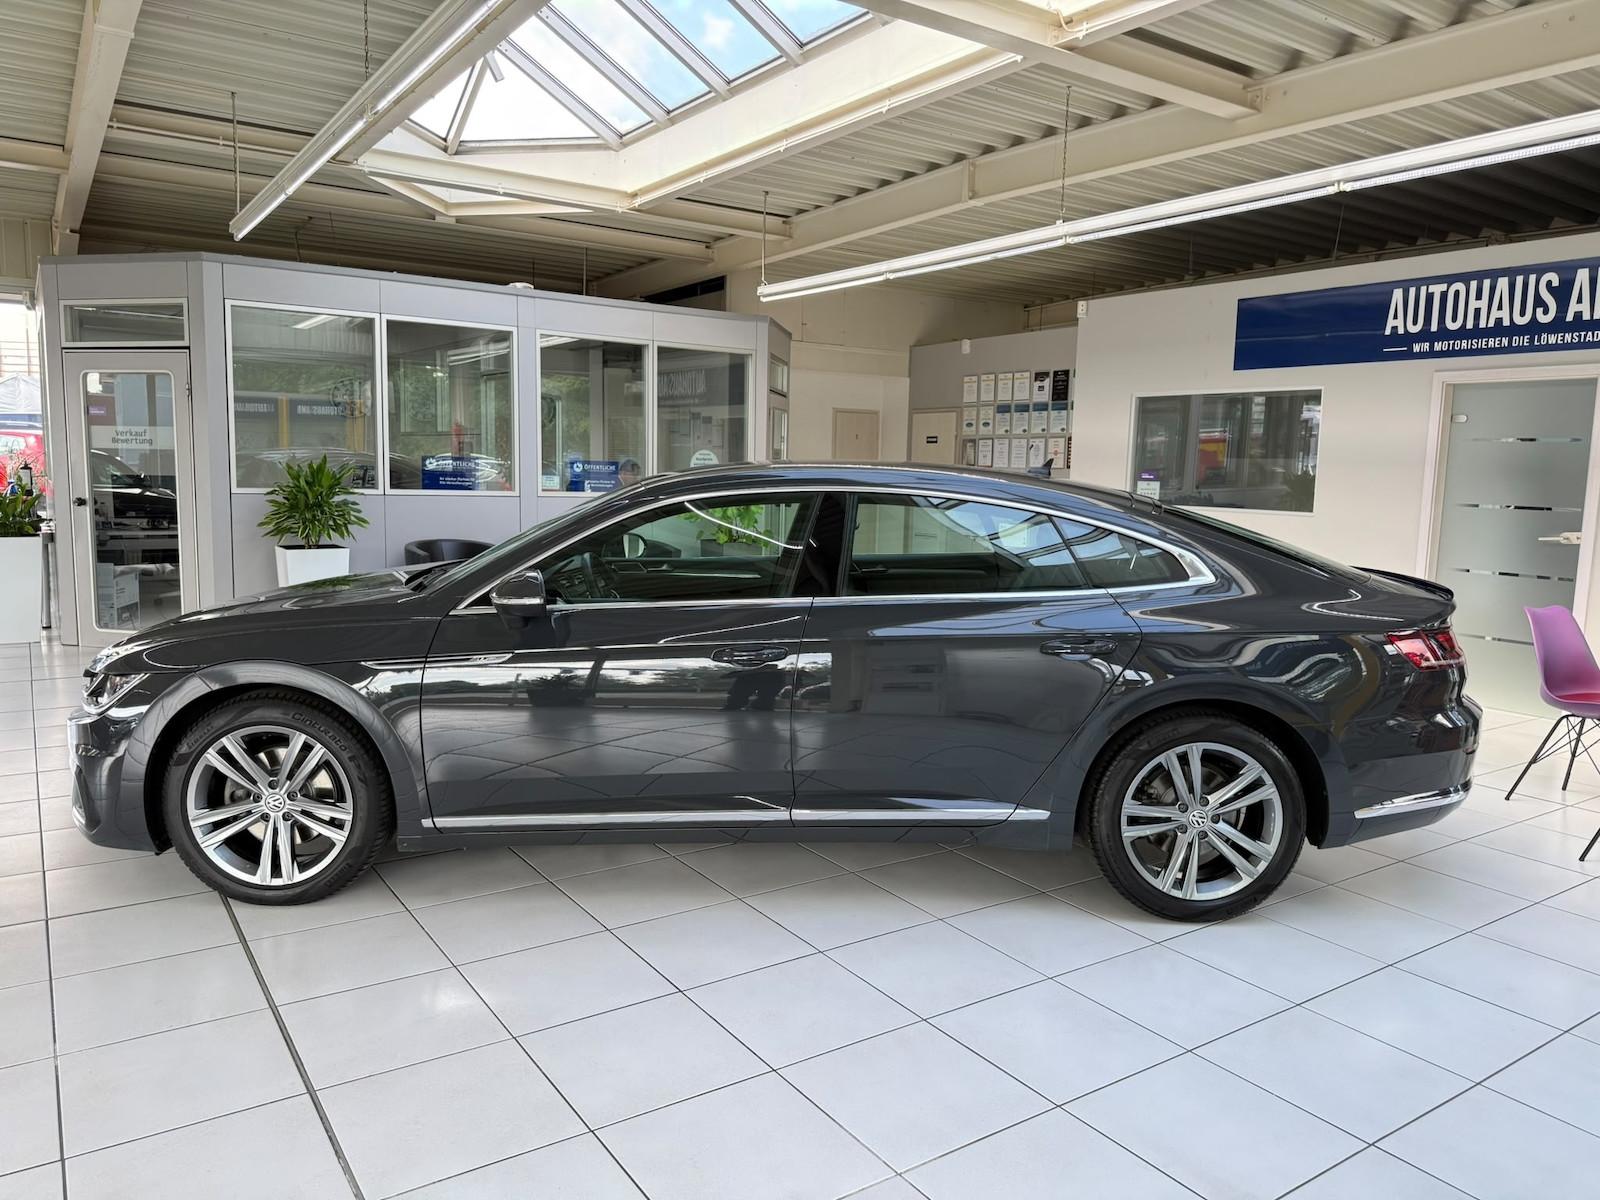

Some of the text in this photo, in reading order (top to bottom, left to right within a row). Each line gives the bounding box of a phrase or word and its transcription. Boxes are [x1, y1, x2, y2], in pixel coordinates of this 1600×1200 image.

[1384, 272, 1559, 336] AUTOHAUS
[1413, 343, 1430, 353] WIR
[1434, 337, 1509, 351] MOTORISIEREN
[1512, 335, 1530, 347] DIE
[112, 437, 153, 446] Bewertung
[291, 712, 349, 752] Cinturato
